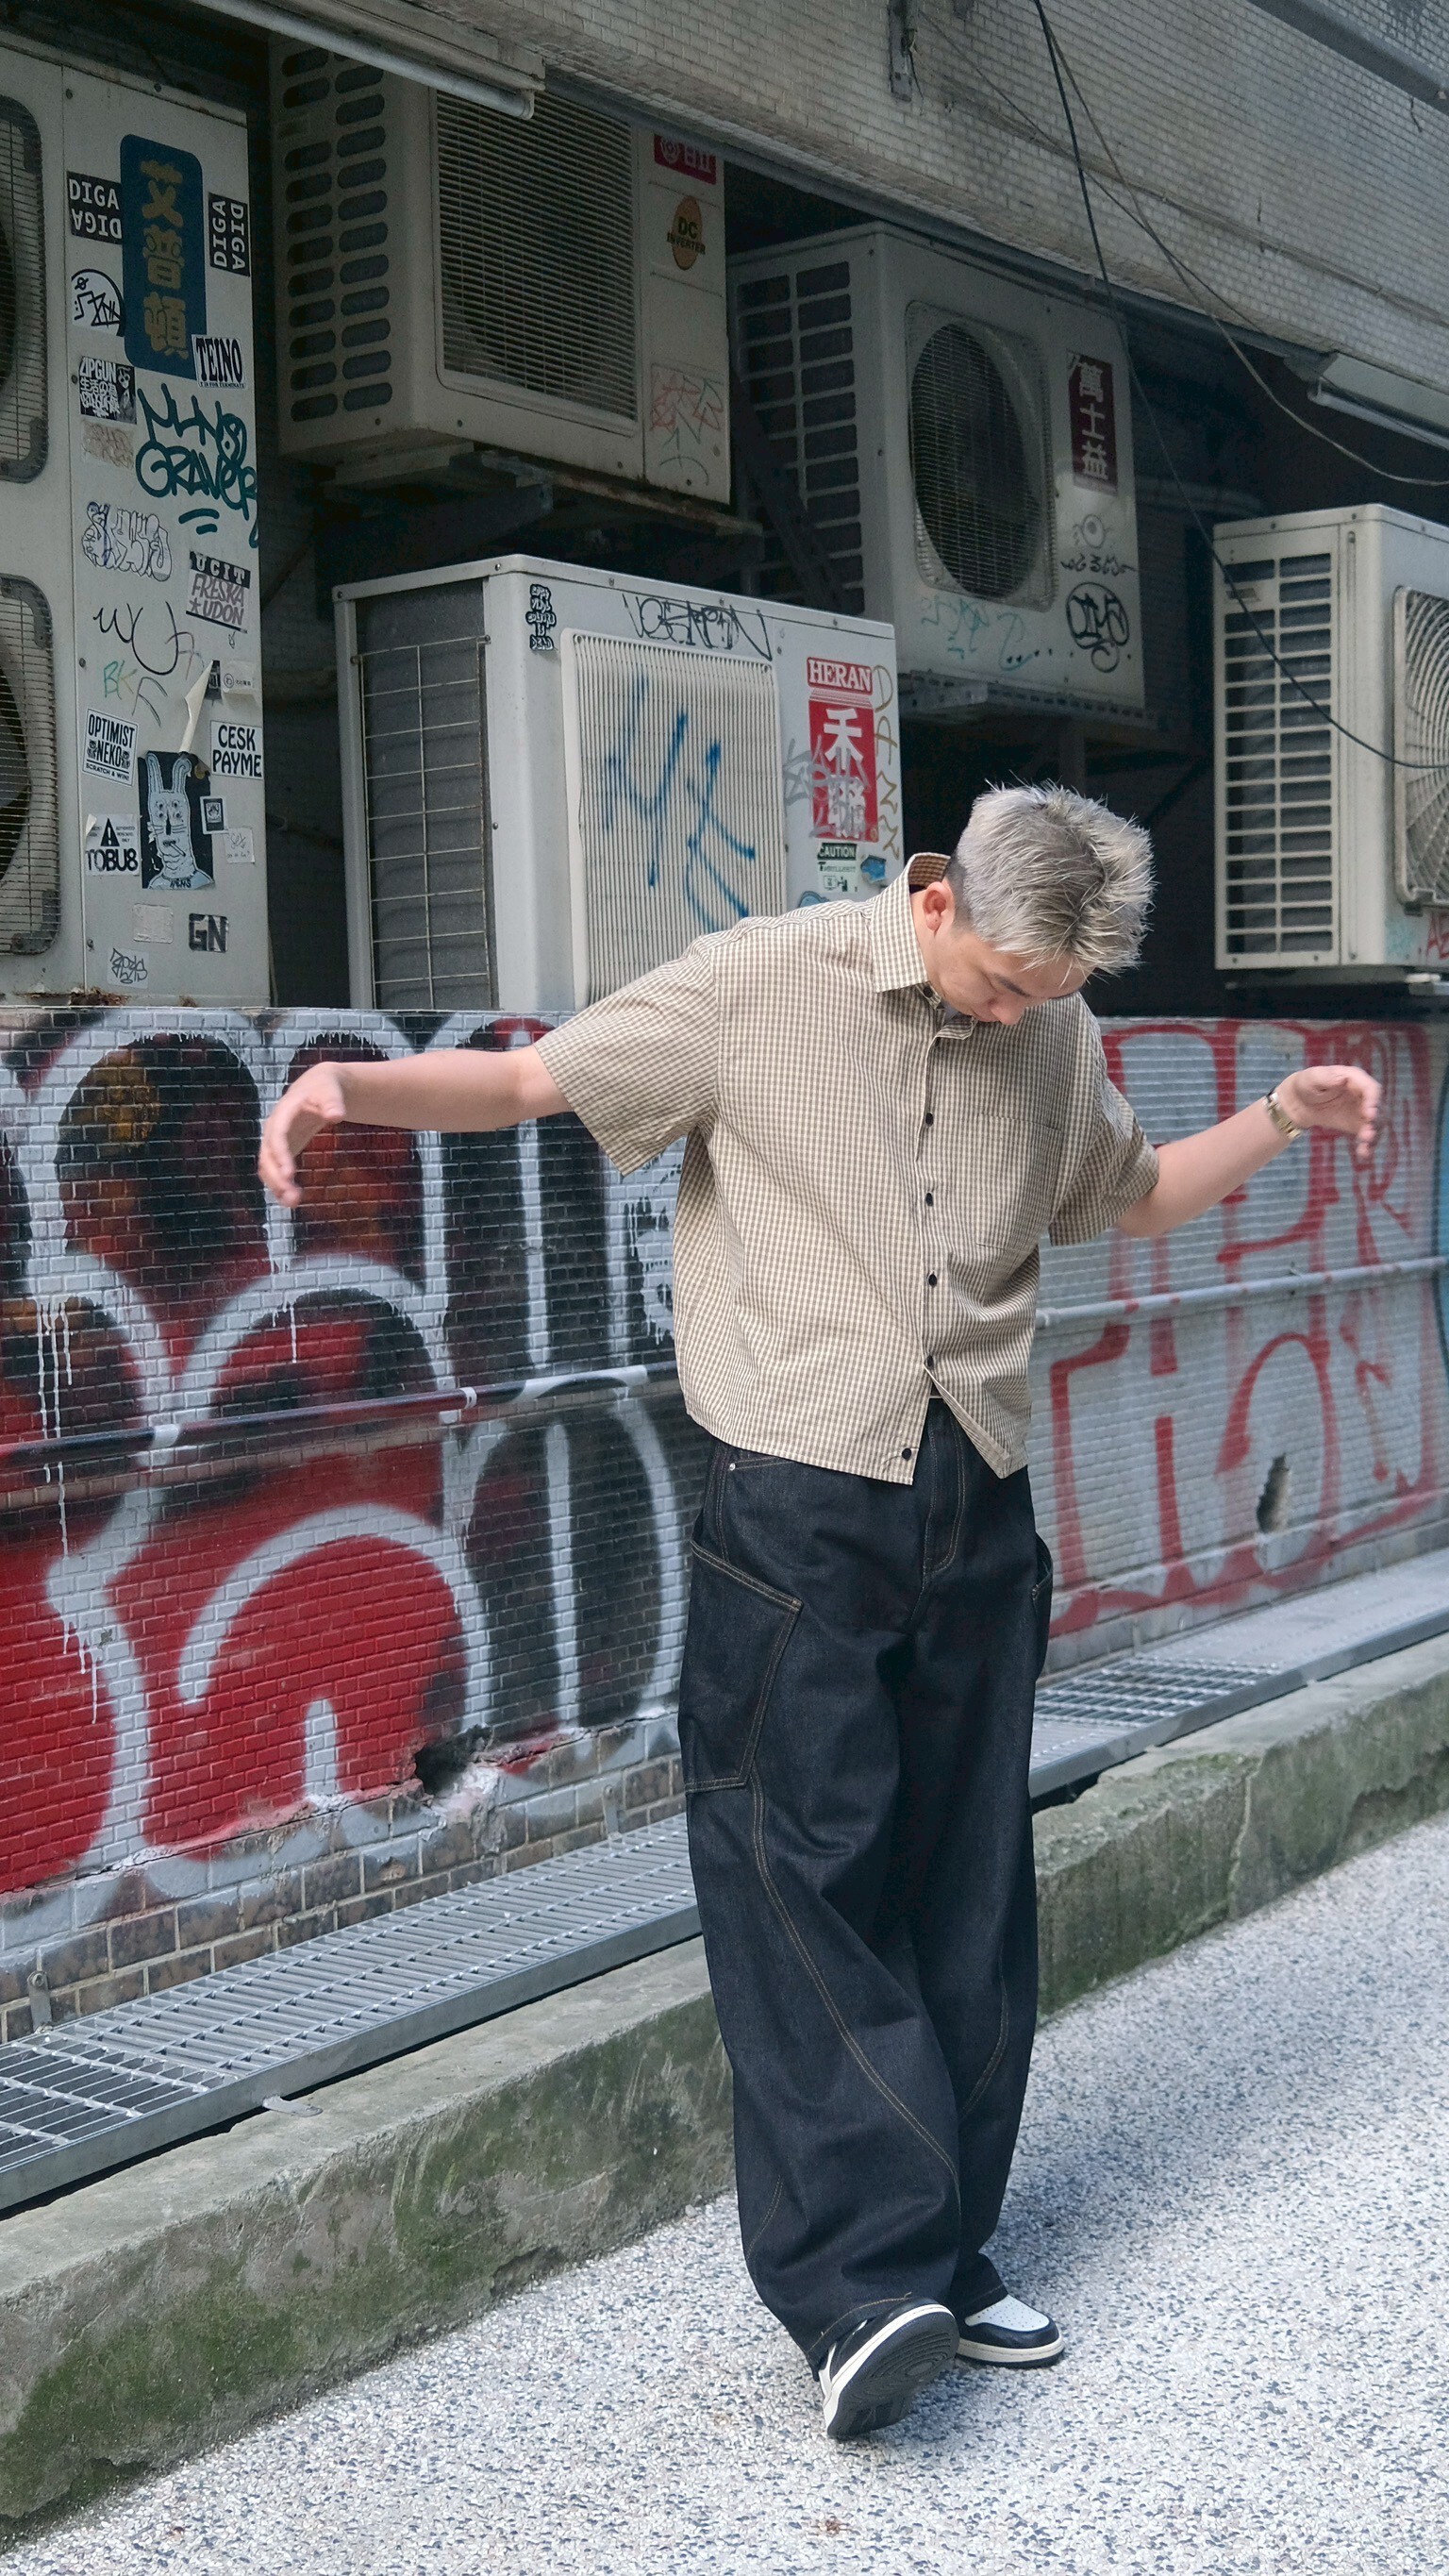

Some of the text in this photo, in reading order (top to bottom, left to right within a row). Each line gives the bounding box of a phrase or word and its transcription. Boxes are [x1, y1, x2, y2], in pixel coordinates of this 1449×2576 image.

[69, 178, 120, 210] DIGA
[71, 208, 122, 240] DIGA
[212, 200, 227, 268] DIGA
[230, 202, 245, 270] DIGA
[678, 216, 698, 239] DC
[667, 232, 706, 255] INVERTER
[195, 337, 242, 383] TEINO
[1078, 361, 1109, 481] 萬士益
[192, 573, 244, 607] FRESKA
[203, 600, 244, 626] UDON
[808, 660, 873, 693] HERAN
[88, 713, 135, 749] OPTIMIST
[218, 725, 256, 752] CESK
[86, 762, 110, 775] SCRATCH
[96, 740, 122, 768] NEKO
[212, 749, 262, 778] PAYME
